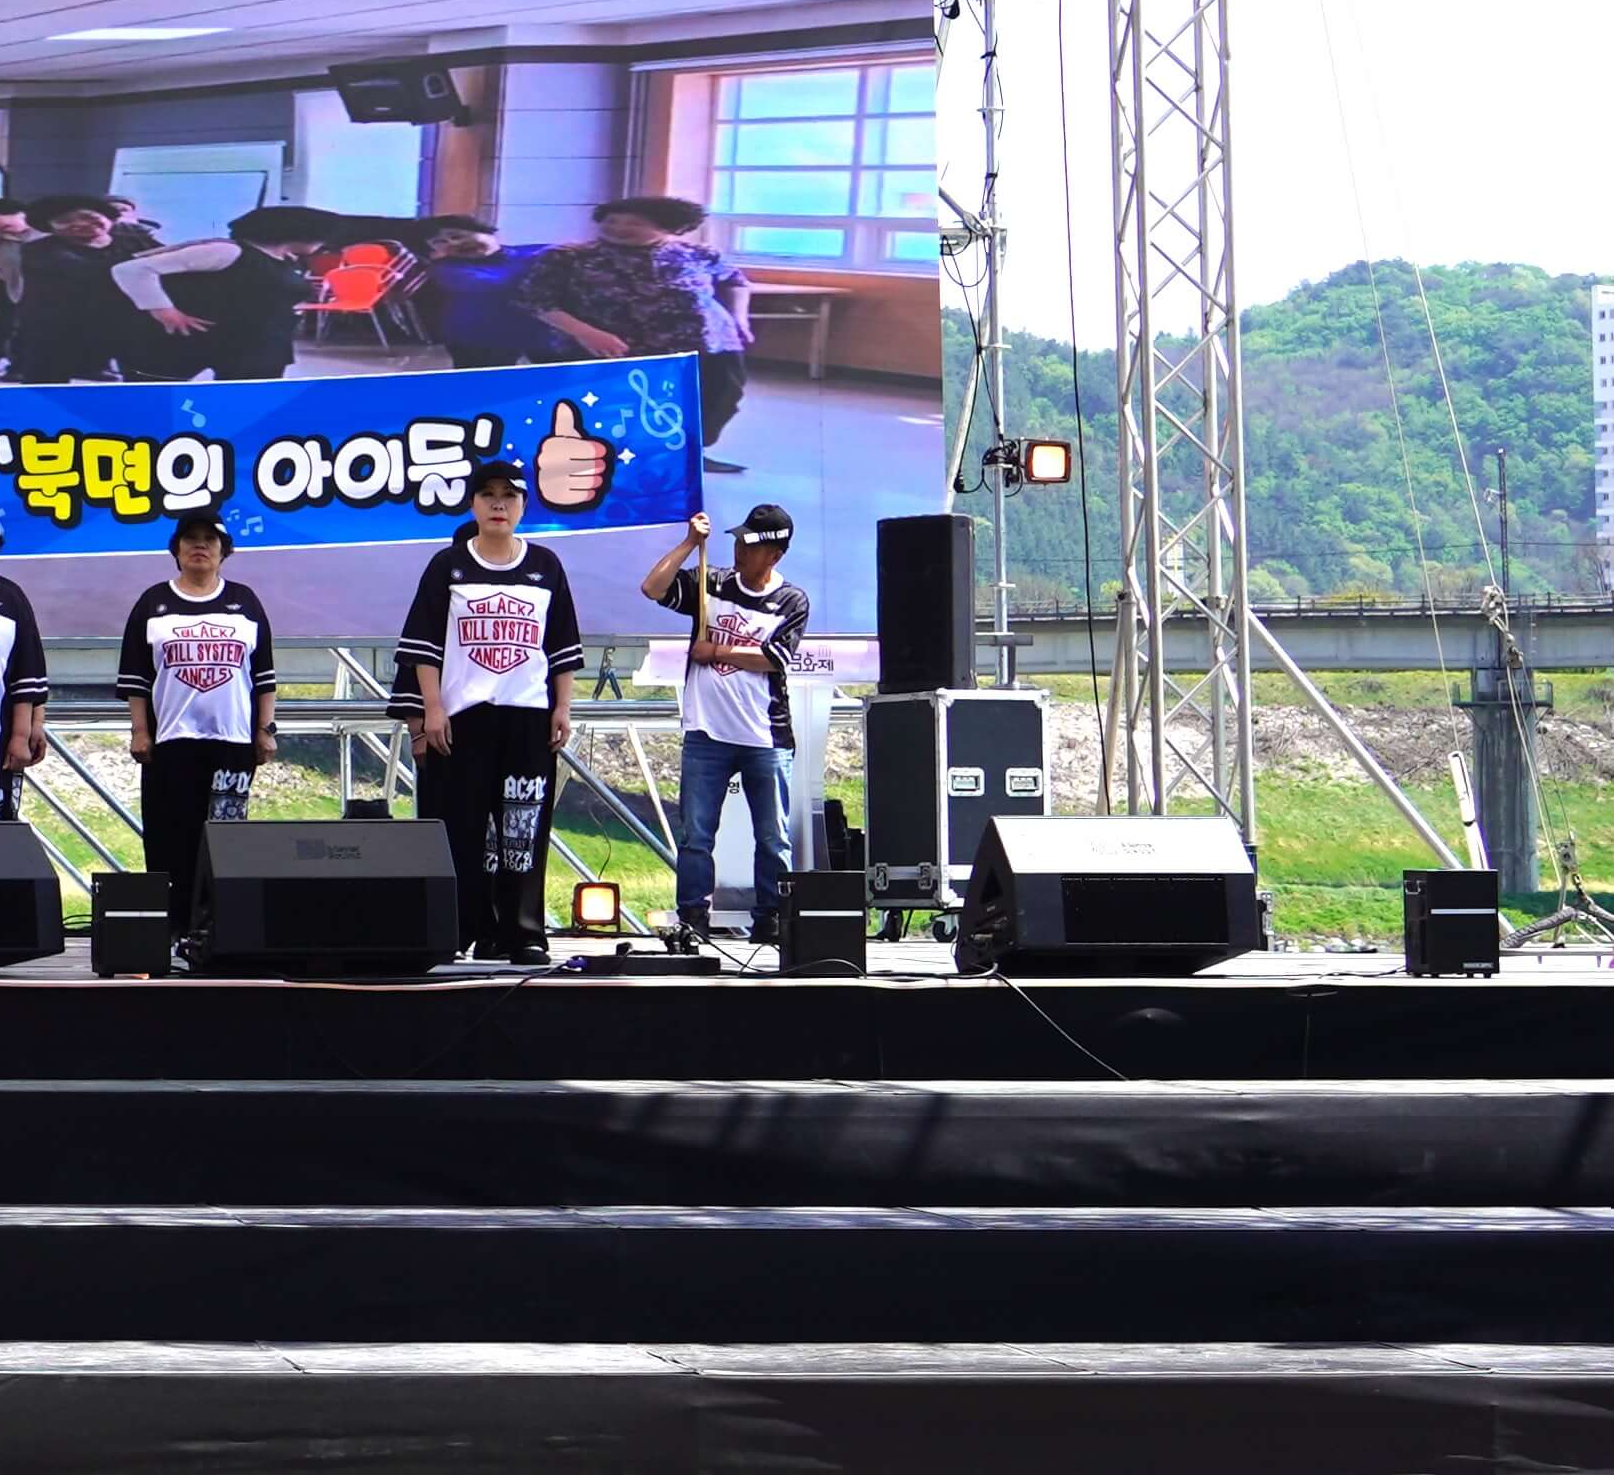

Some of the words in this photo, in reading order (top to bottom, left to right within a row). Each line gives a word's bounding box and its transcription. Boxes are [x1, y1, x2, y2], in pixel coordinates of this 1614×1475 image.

[476, 597, 525, 616] BLACK
[462, 620, 488, 641] KILL
[493, 620, 539, 645] SYSTEM
[197, 643, 243, 663] SYSTEM
[475, 647, 522, 669] ANGELS
